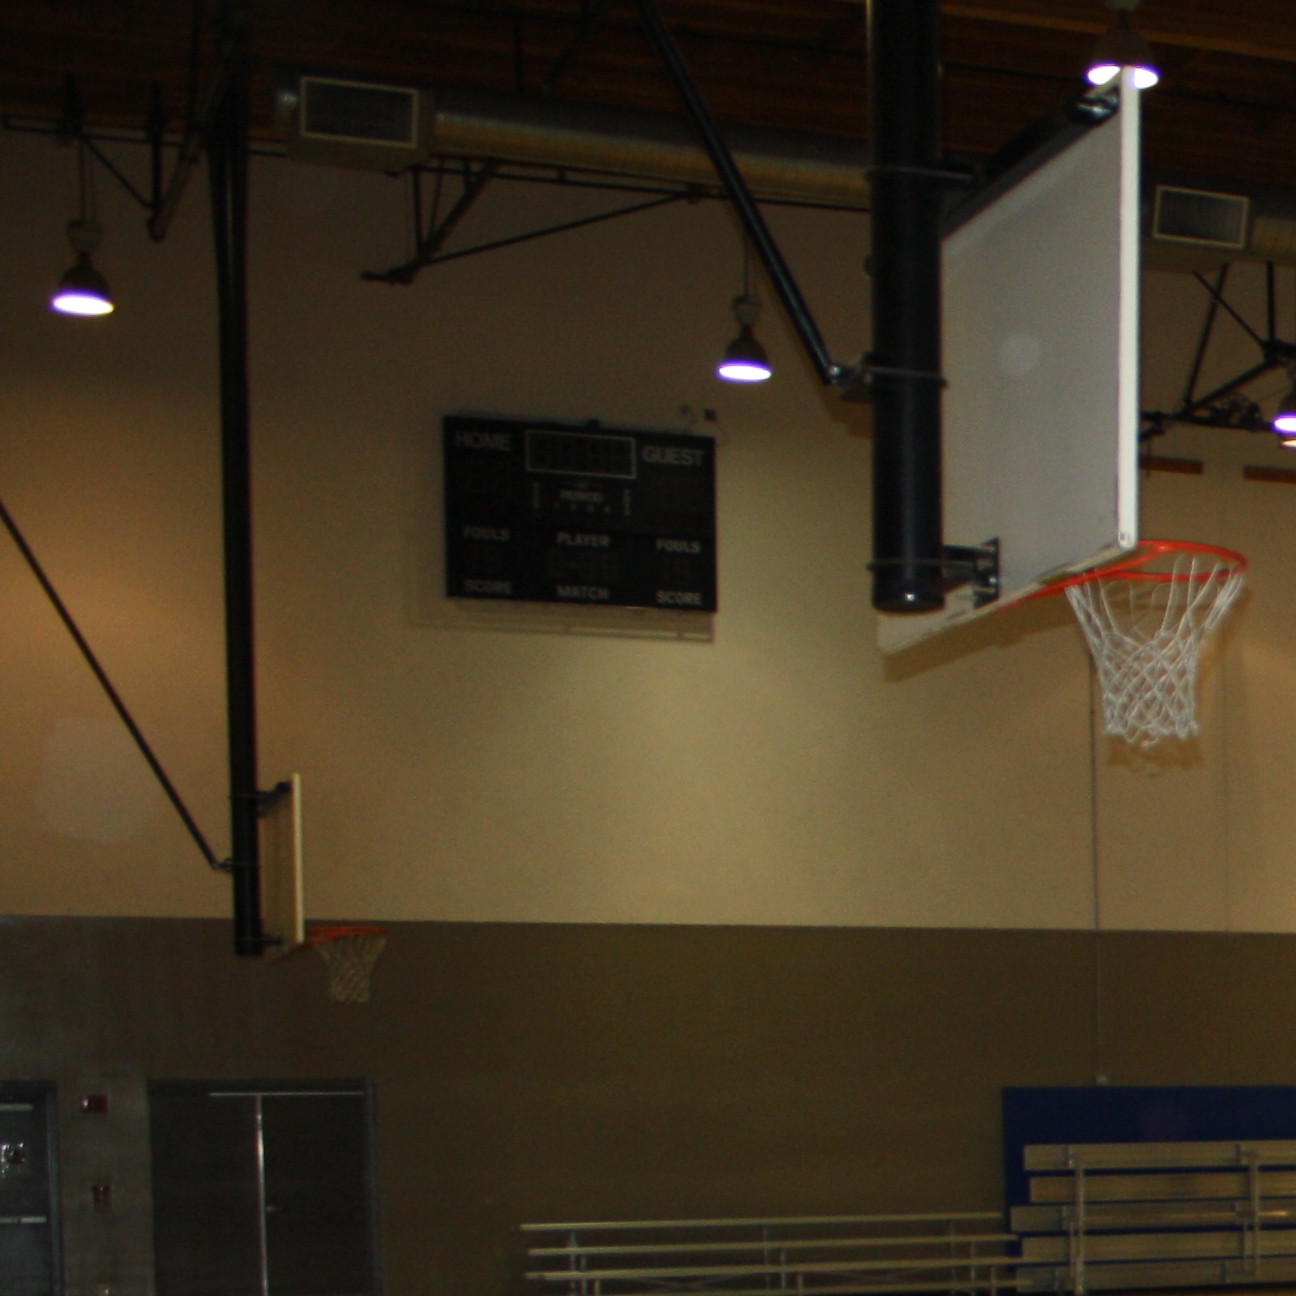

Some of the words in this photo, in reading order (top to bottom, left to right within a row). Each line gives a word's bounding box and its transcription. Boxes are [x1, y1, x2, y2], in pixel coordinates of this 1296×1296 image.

[455, 432, 511, 451] HOME
[642, 446, 705, 466] GUEST
[463, 526, 510, 541] FOULS
[556, 532, 611, 548] PLAYER
[656, 539, 701, 554] FOULS
[464, 579, 512, 594] SCORE
[557, 586, 609, 601] MATCH
[656, 590, 702, 606] SCORE
